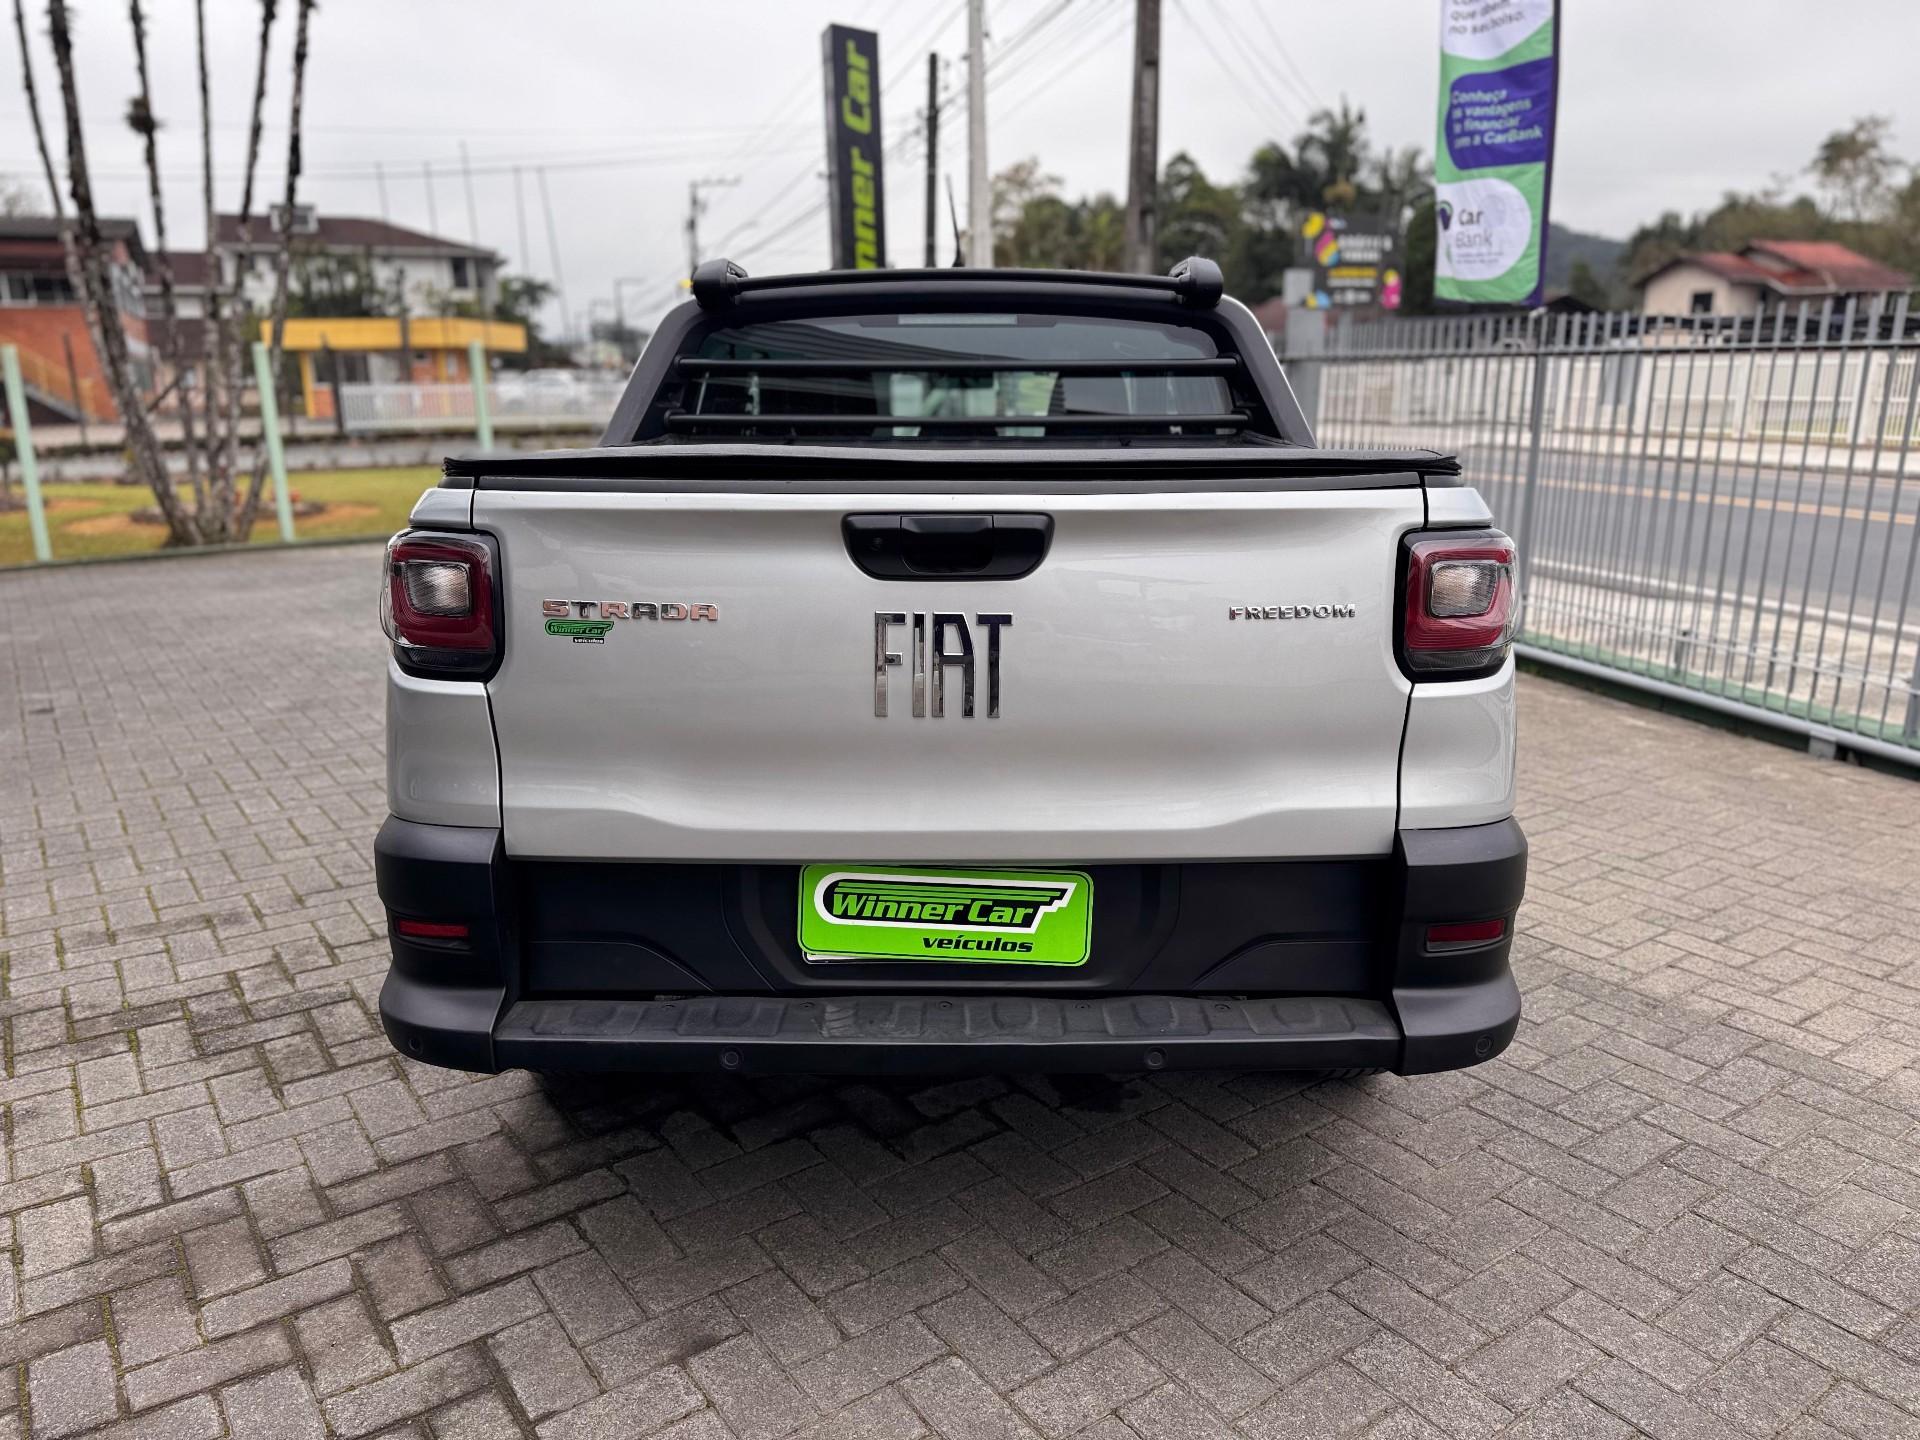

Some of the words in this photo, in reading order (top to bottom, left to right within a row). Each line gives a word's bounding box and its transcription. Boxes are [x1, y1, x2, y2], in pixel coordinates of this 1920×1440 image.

[842, 40, 871, 134] Car
[1483, 124, 1543, 145] CarBank
[852, 146, 878, 269] nner
[1458, 208, 1484, 226] Car
[1455, 228, 1493, 249] Bank
[542, 599, 719, 622] STRADA
[1229, 602, 1356, 620] FREEDOM
[550, 624, 585, 634] Winner
[874, 610, 1014, 718] FIAT
[832, 892, 964, 922] Winner
[966, 899, 1034, 924] Car
[922, 934, 1034, 953] veículos
